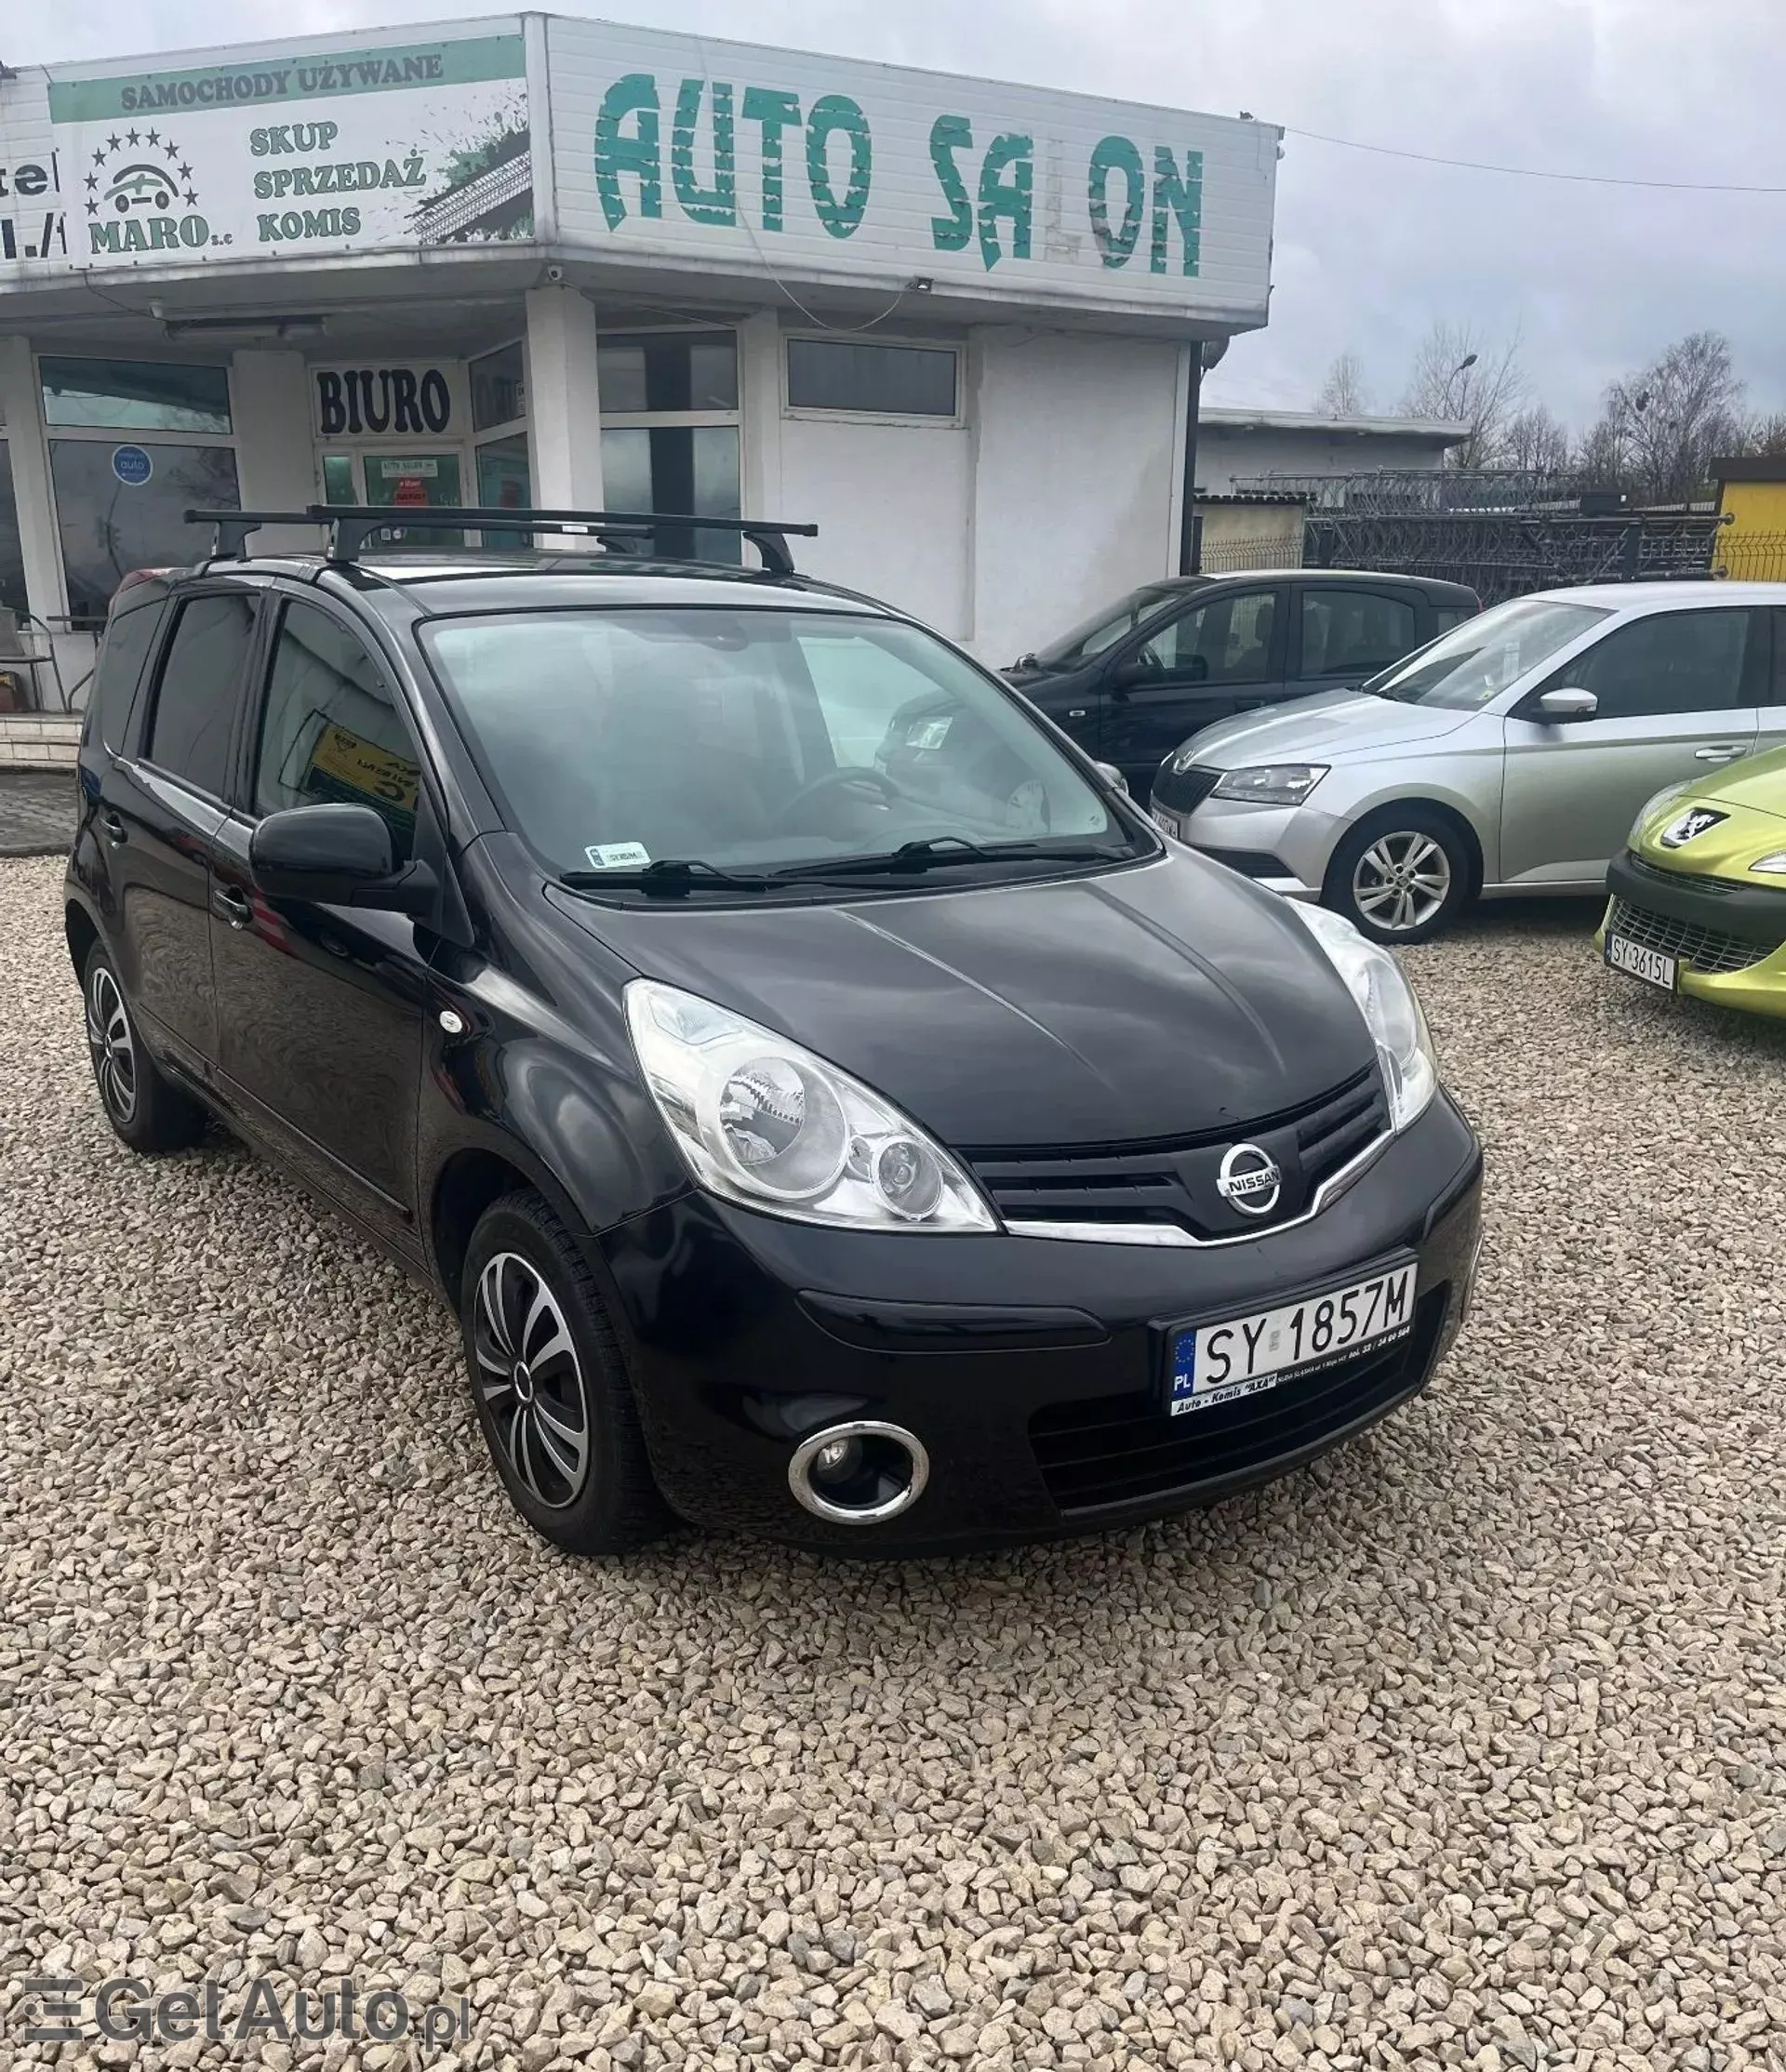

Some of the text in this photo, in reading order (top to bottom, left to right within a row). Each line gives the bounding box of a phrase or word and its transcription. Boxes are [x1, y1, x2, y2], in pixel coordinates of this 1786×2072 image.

[121, 70, 291, 111] SAMOCHODY
[249, 121, 339, 156] SKUP
[594, 73, 873, 238] AUTO
[254, 148, 427, 200] SPRZEDAŻ
[88, 215, 209, 254] MARO
[257, 206, 362, 243] KOMIS
[316, 368, 451, 434] BIURO
[1614, 937, 1671, 986] SY 3615L
[1228, 1169, 1279, 1192] NISSAN
[1206, 1270, 1409, 1384] SY 1857M
[1174, 1374, 1192, 1391] PL
[1177, 1398, 1202, 1414] Auto
[1211, 1386, 1242, 1403] Komis
